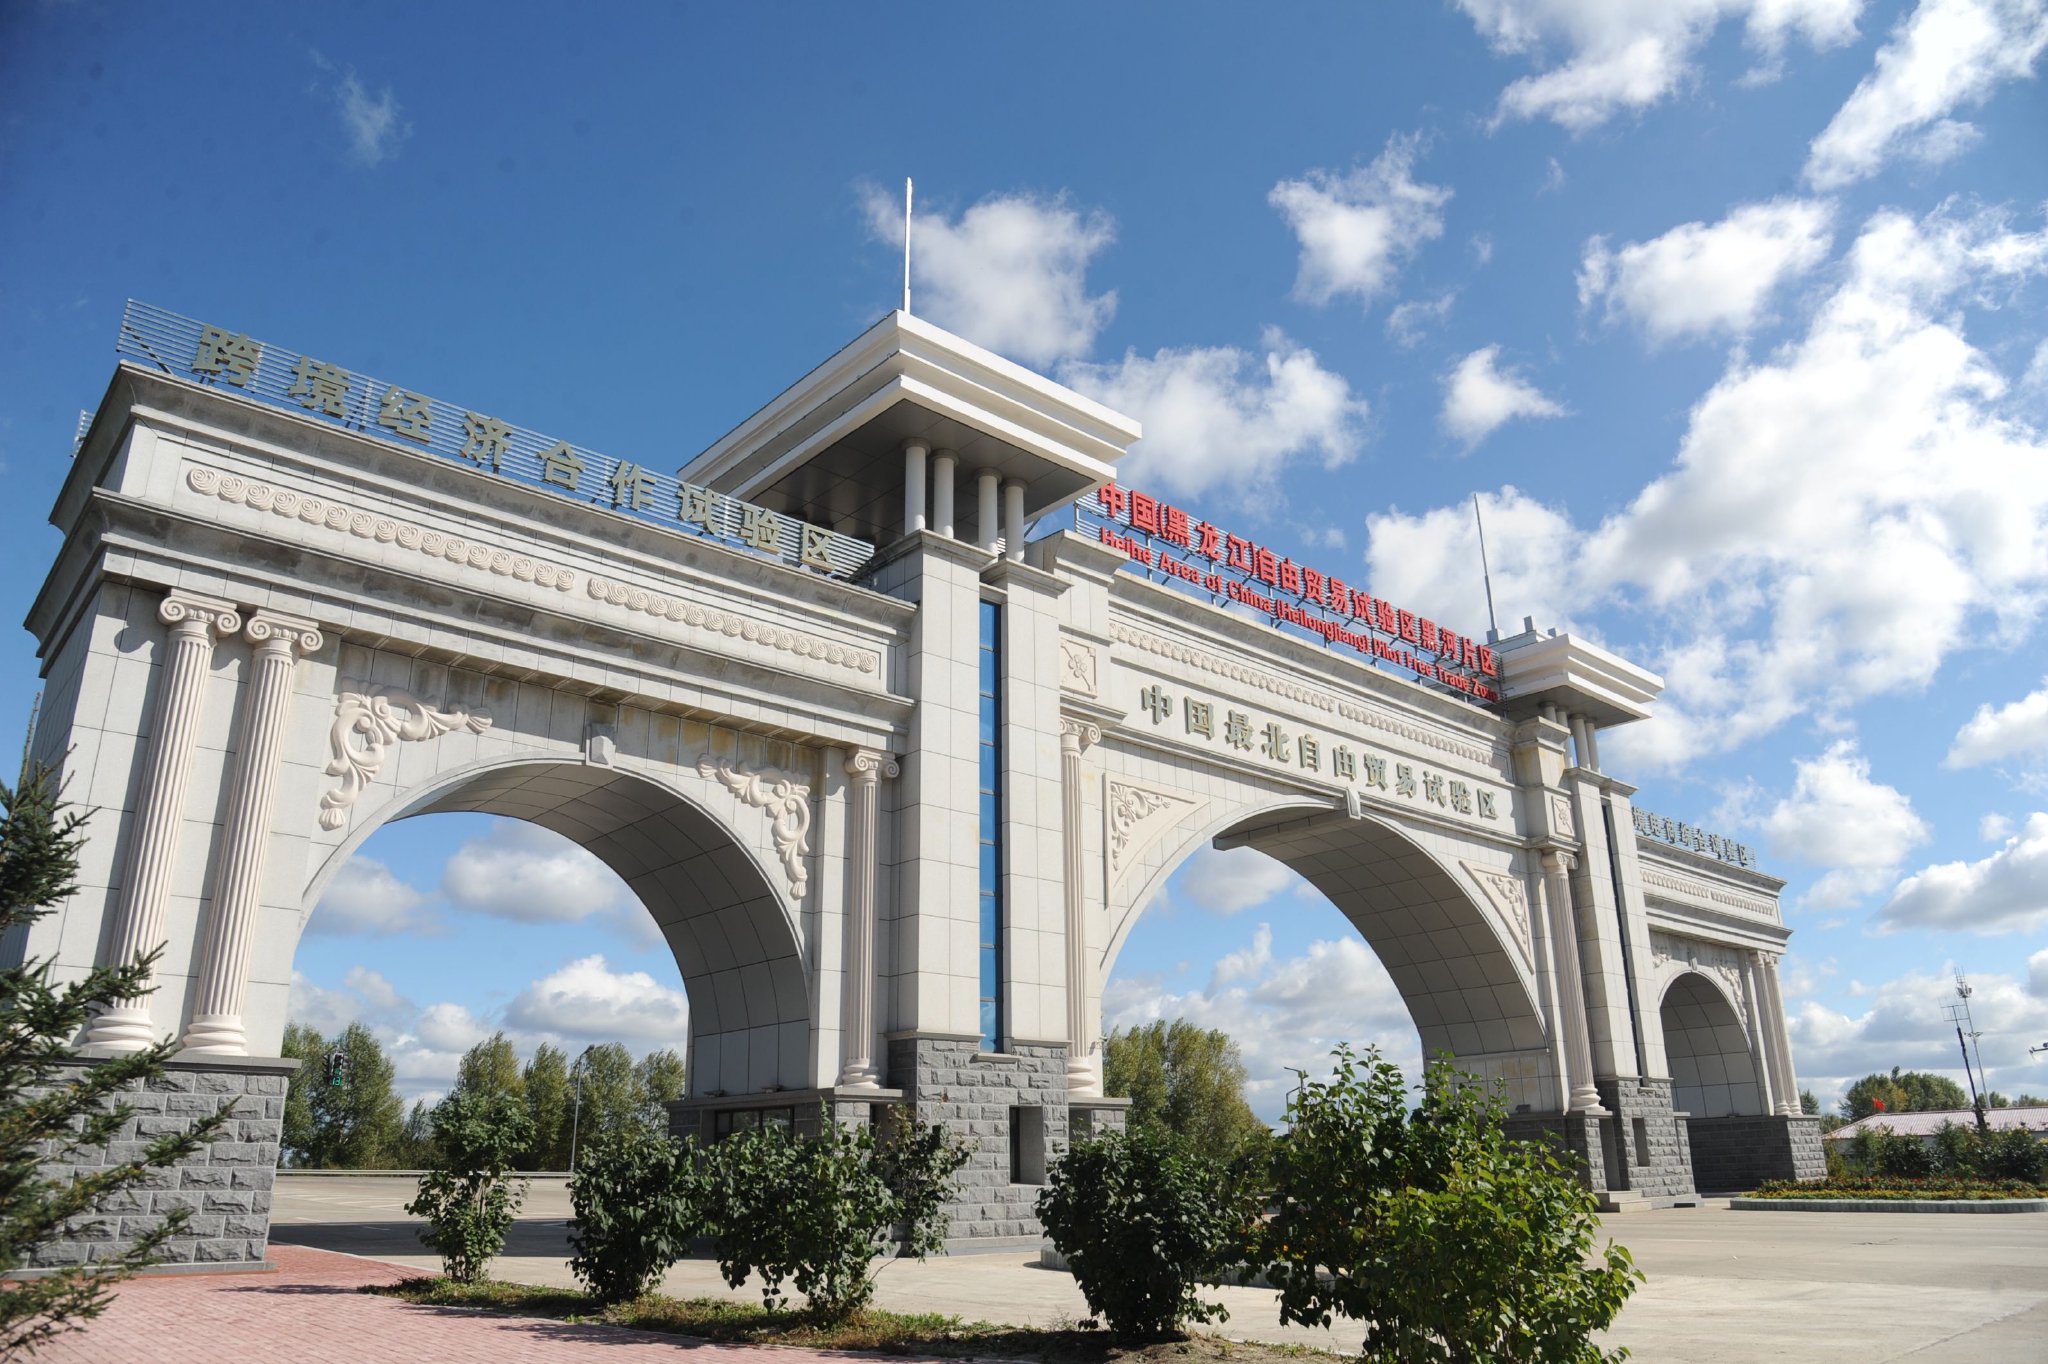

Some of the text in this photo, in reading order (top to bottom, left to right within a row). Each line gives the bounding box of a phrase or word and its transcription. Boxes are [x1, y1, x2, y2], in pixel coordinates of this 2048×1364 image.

[191, 323, 836, 572] 跨境经济合作试验区
[1100, 527, 1500, 704] Heihe Area of China (Heilongjiang) Pilot Free Trade Zone
[1141, 684, 1499, 819] 中国最北自由贸易试验区
